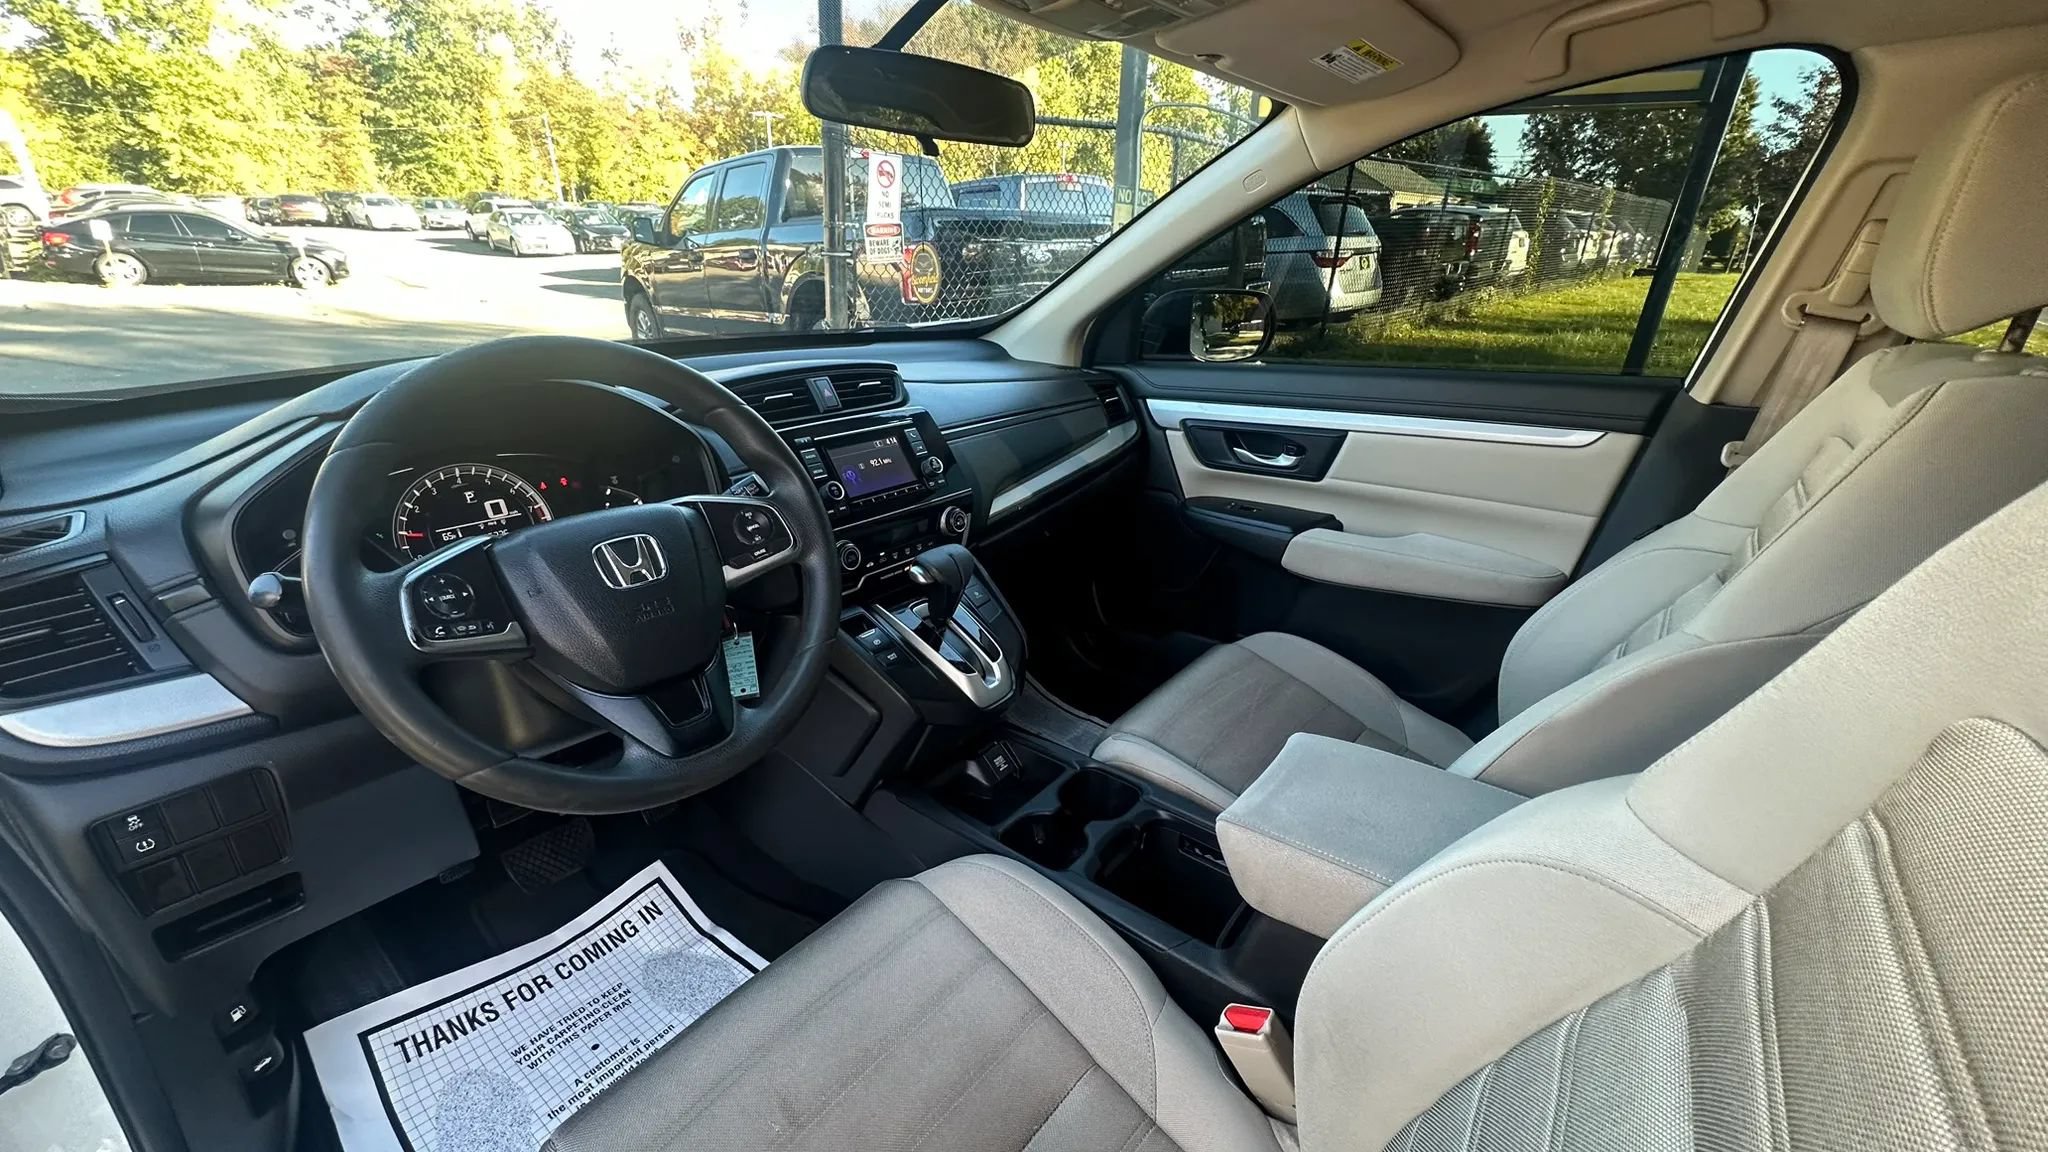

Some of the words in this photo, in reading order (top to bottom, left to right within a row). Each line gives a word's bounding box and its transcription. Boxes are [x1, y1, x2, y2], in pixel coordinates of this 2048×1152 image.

[881, 190, 889, 198] NO
[1117, 187, 1154, 206] NOICE
[869, 239, 889, 247] BEWARE
[869, 247, 876, 255] OF
[431, 487, 438, 496] 3
[484, 498, 509, 518] 0
[393, 1001, 500, 1063] THANKS
[501, 974, 554, 1011] FOR
[554, 919, 640, 980] COMING
[637, 900, 664, 925] IN
[510, 1043, 529, 1058] WE
[529, 1024, 557, 1046] HAVE
[556, 1006, 586, 1027] TRIED
[587, 997, 600, 1008] TO
[600, 982, 623, 999] KEEP
[515, 1043, 546, 1066] YOUR
[547, 1008, 601, 1045] CARPETING
[601, 988, 632, 1009] CLEAN
[527, 1048, 556, 1070] WITH
[556, 1031, 580, 1050] THIS
[580, 1011, 612, 1034] PAPER
[613, 998, 633, 1013] MAT
[547, 1104, 566, 1120] the
[567, 1083, 594, 1105] most
[595, 1047, 643, 1085] important
[643, 1024, 675, 1051] person
[574, 1078, 584, 1087] A
[584, 1044, 629, 1080] customer
